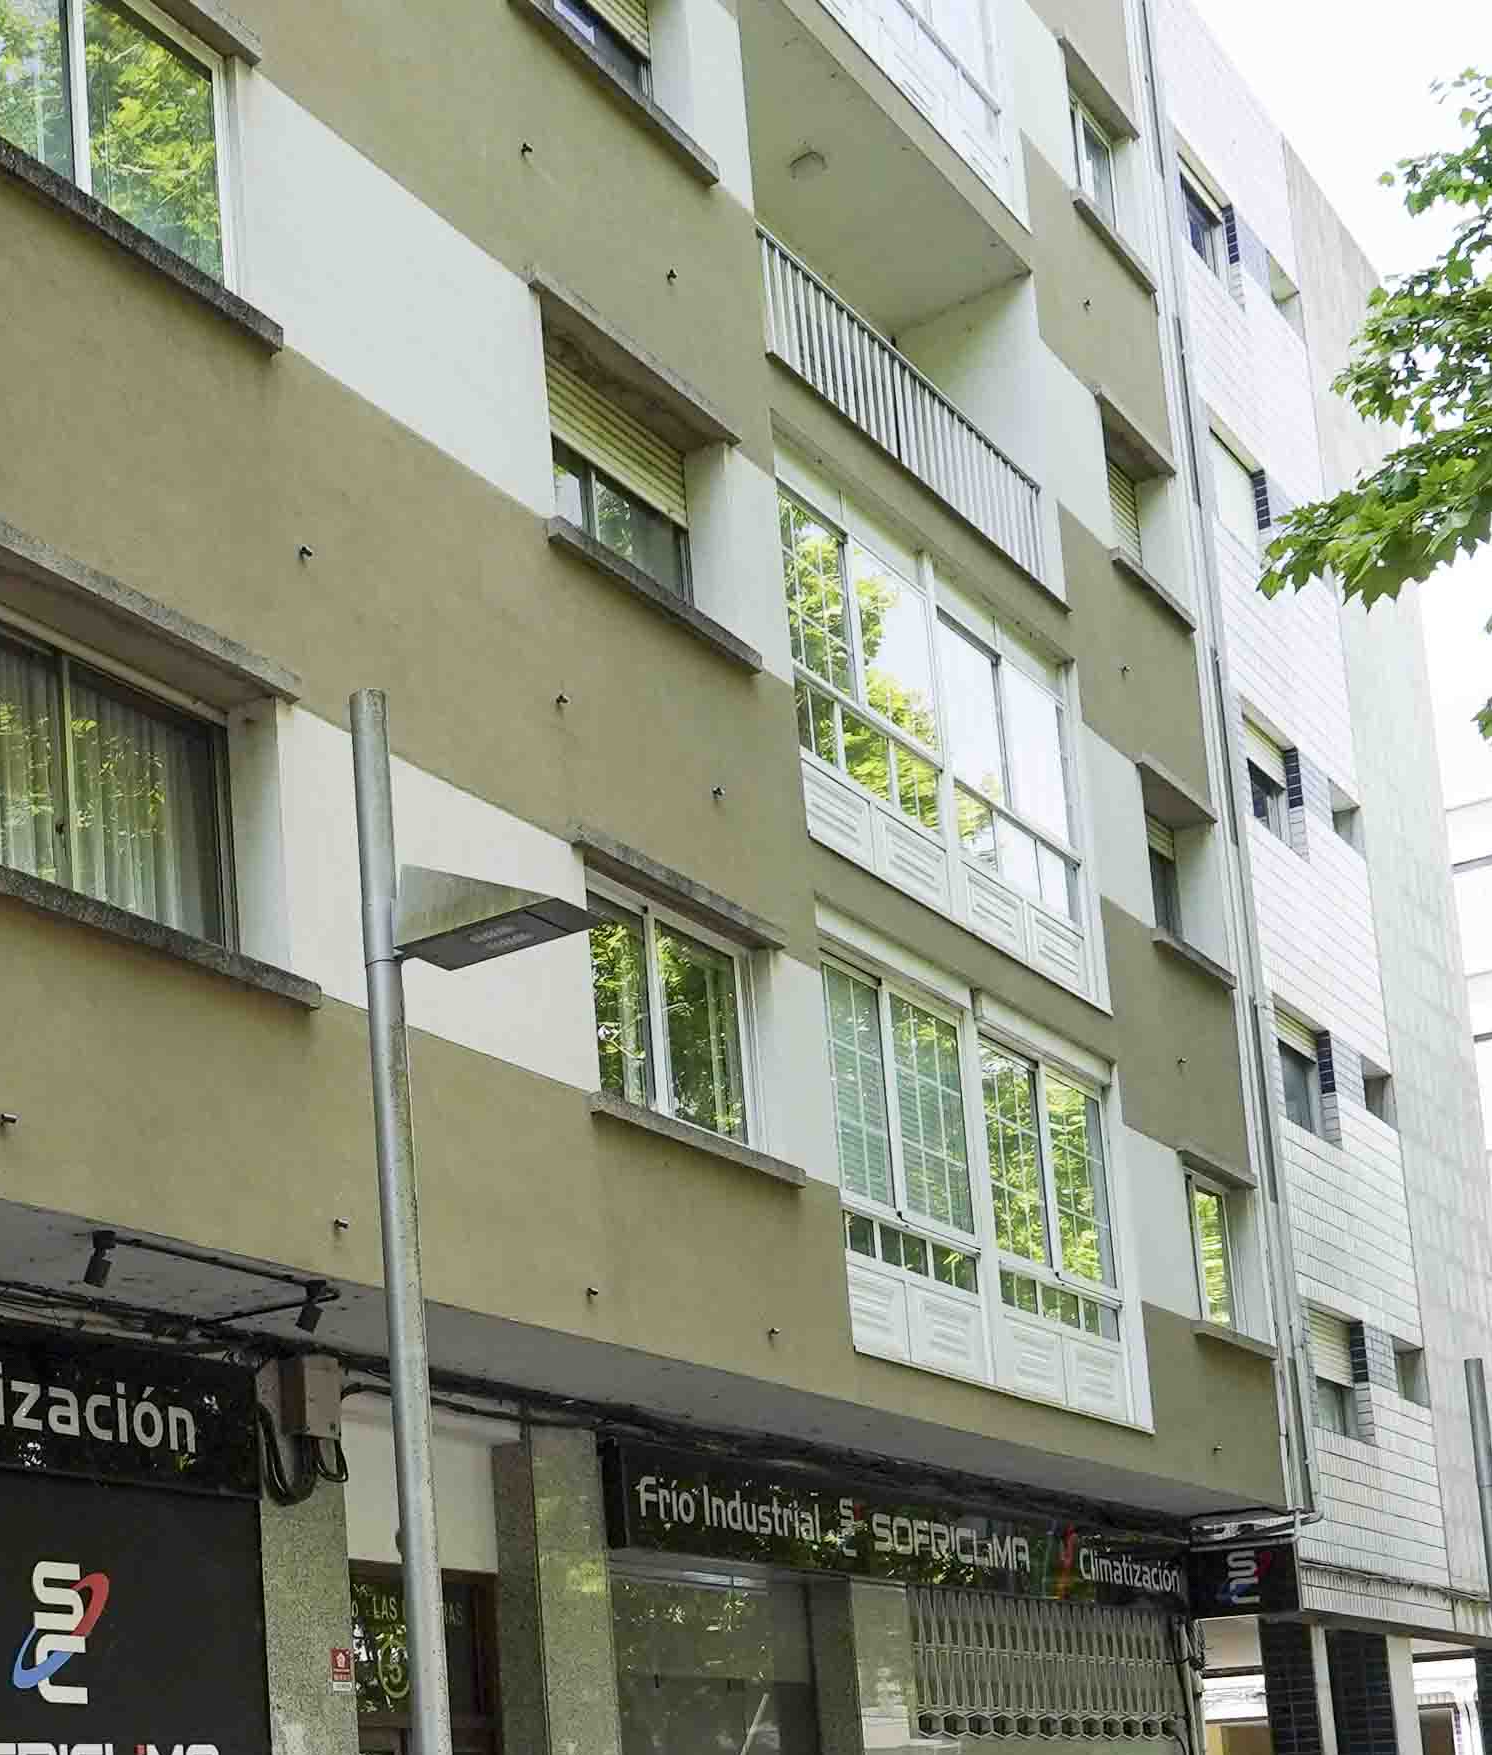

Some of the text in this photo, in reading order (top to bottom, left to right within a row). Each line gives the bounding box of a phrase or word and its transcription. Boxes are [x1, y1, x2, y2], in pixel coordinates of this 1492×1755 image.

[639, 1476, 821, 1543] Frío Industrial
[1079, 1548, 1182, 1593] Climatización
